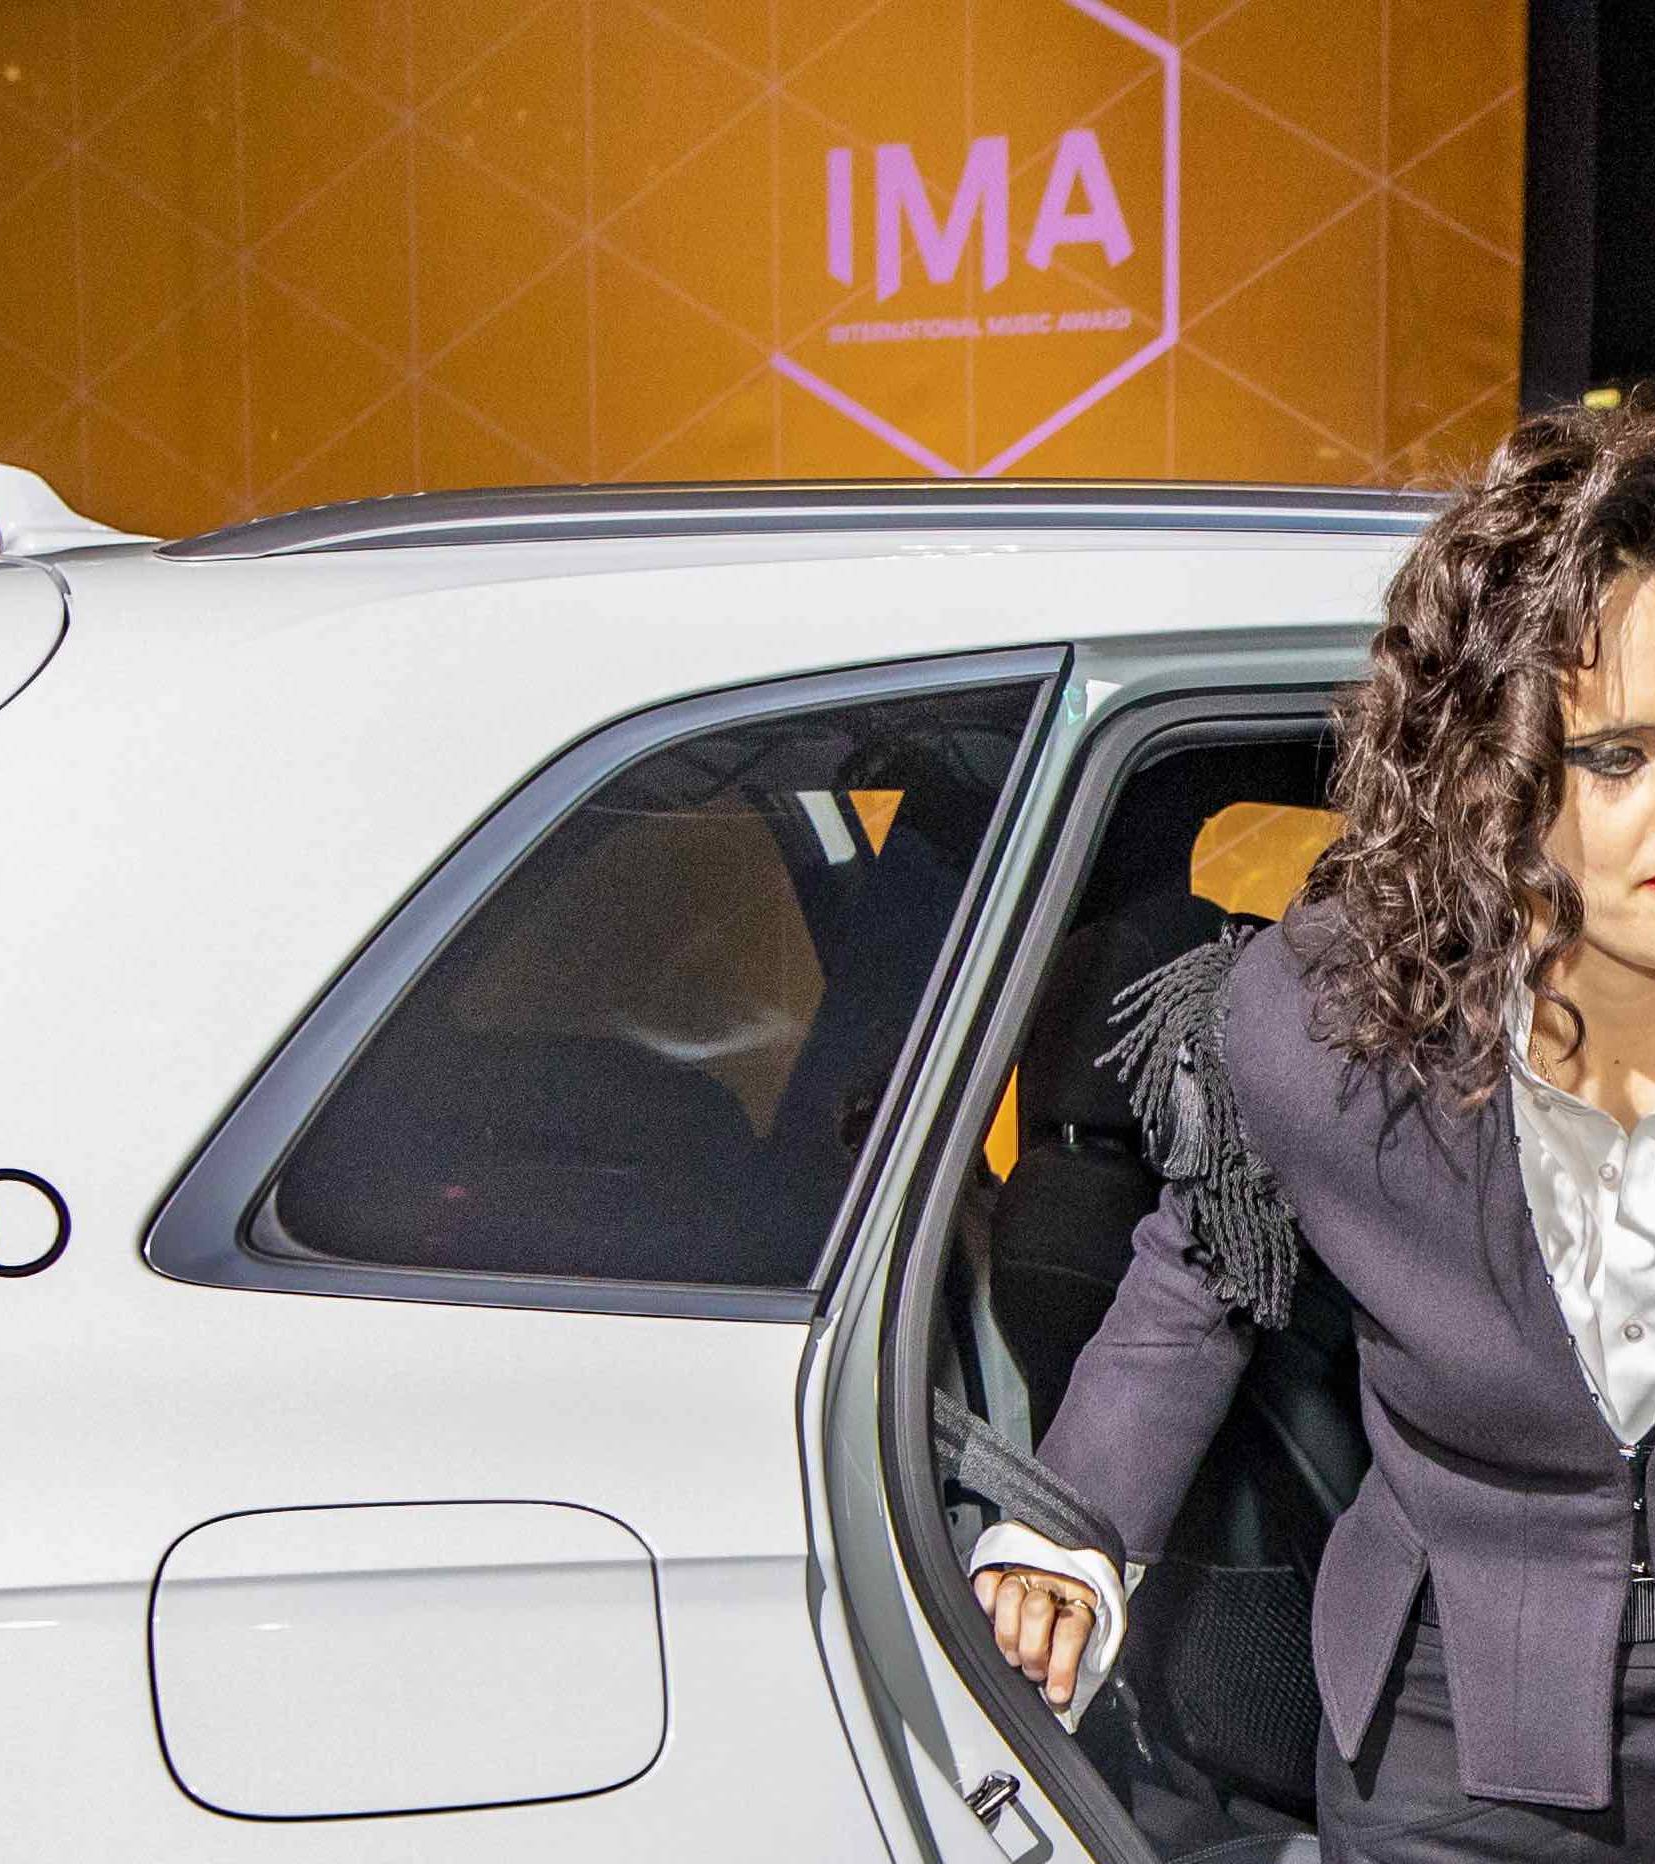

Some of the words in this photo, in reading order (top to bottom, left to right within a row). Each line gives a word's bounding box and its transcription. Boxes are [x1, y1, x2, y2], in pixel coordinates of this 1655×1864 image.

[826, 129, 1134, 303] IMA
[828, 318, 982, 345] INTERNATIONAL
[986, 312, 1051, 337] MUSIC
[1057, 307, 1133, 332] AWARD
